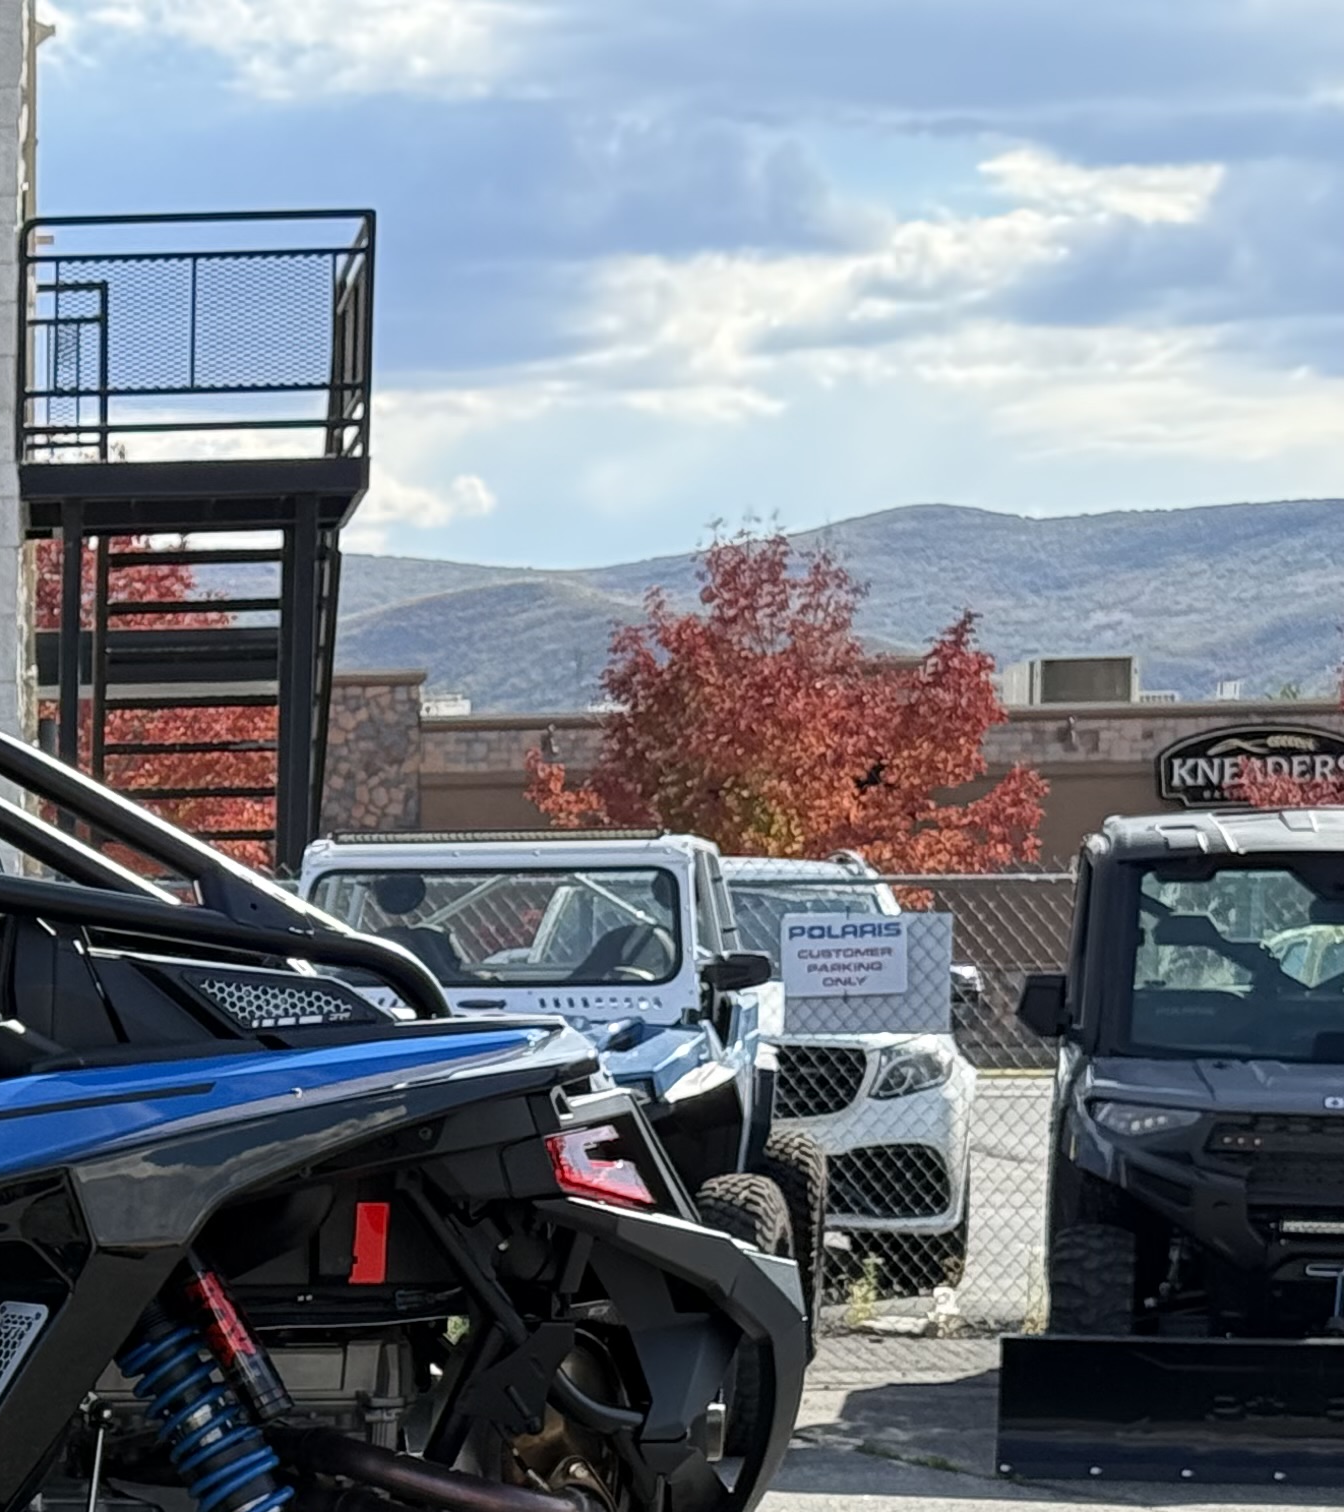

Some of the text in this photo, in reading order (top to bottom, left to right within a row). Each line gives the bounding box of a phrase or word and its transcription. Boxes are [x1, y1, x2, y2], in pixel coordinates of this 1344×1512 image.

[788, 922, 902, 940] POLARIS
[797, 947, 893, 960] CUSTOMER
[807, 961, 883, 974] PARKING
[822, 975, 867, 987] ONLY
